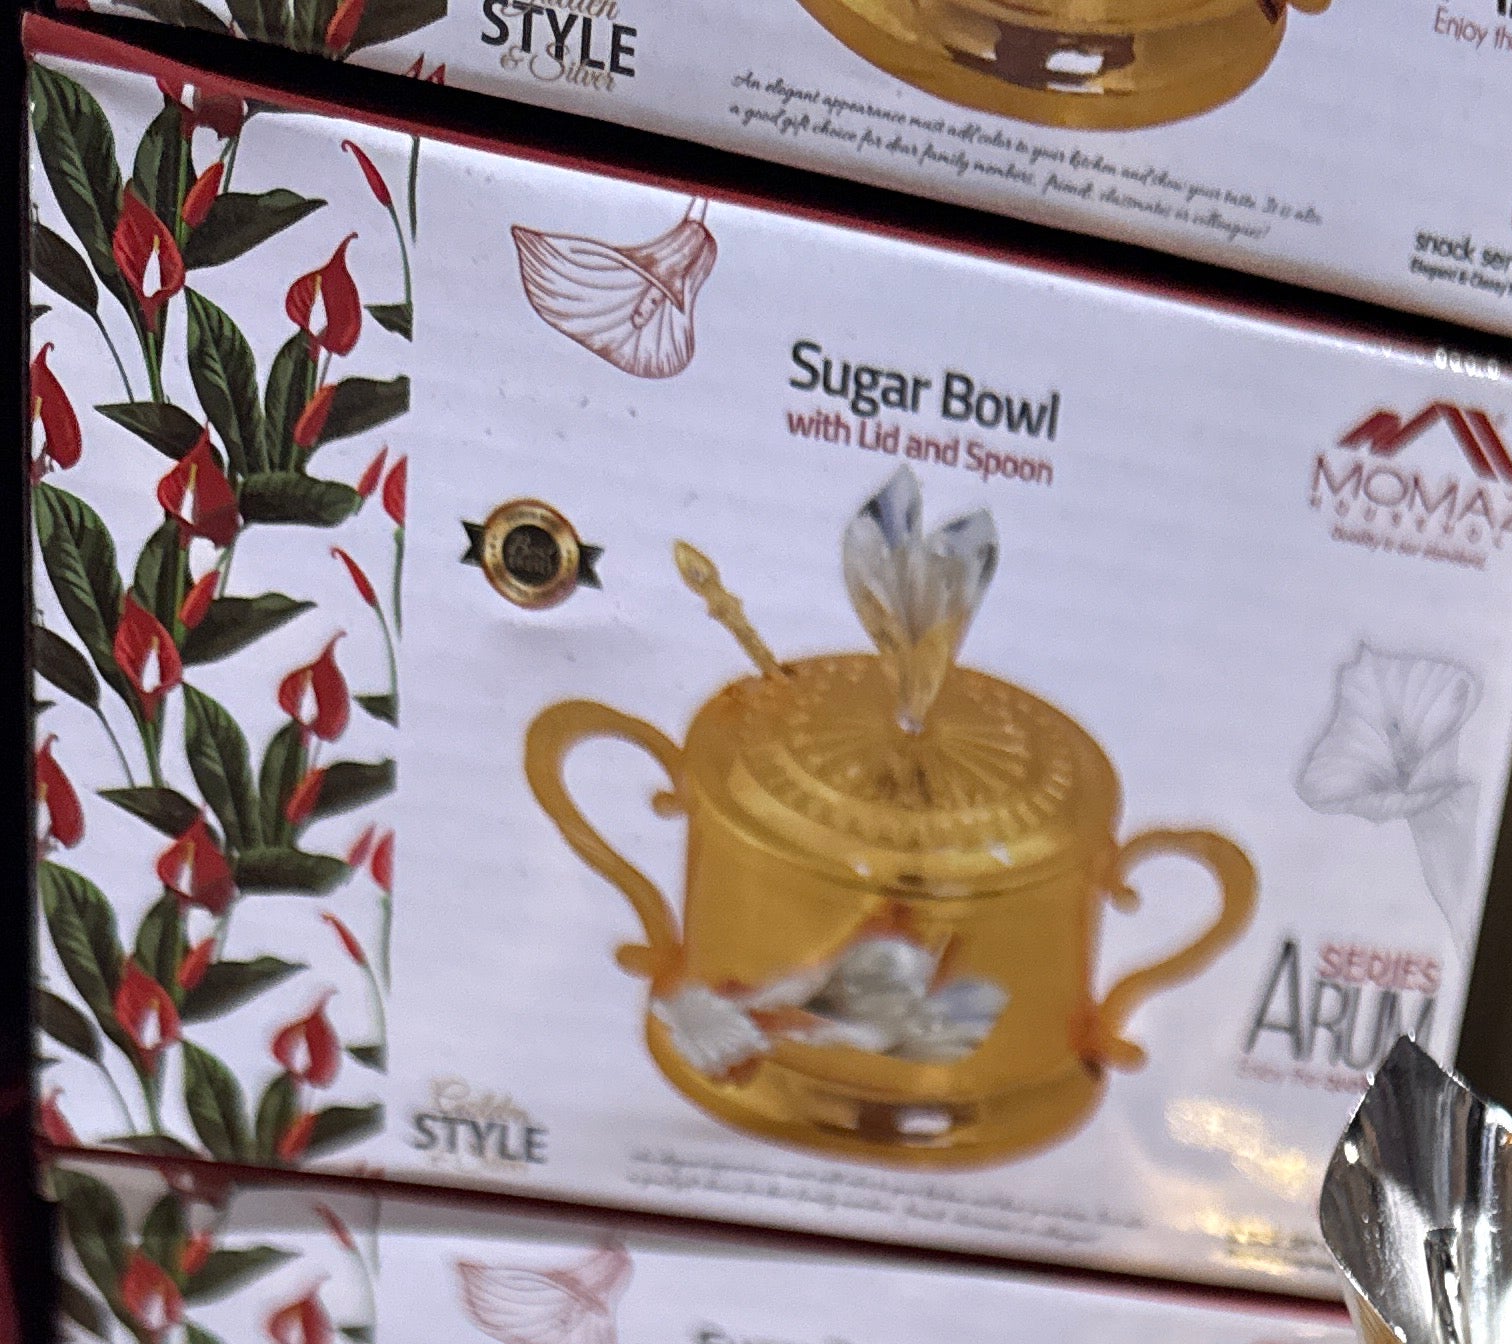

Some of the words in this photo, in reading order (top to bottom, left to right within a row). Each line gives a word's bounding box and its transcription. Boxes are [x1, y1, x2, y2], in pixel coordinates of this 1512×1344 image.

[481, 0, 637, 77] STYLE
[1434, 5, 1488, 48] Enjoy
[731, 71, 760, 91] An
[765, 78, 820, 104] elegant
[822, 97, 906, 123] appearance
[1416, 229, 1475, 263] snack
[789, 340, 932, 418] Sugar
[942, 369, 1060, 441] Bowl
[787, 410, 851, 445] with
[858, 419, 900, 455] Lid
[905, 431, 960, 468] and
[966, 438, 1054, 486] Spoon
[1319, 942, 1440, 995] SERIES
[414, 1111, 549, 1165] STYLE
